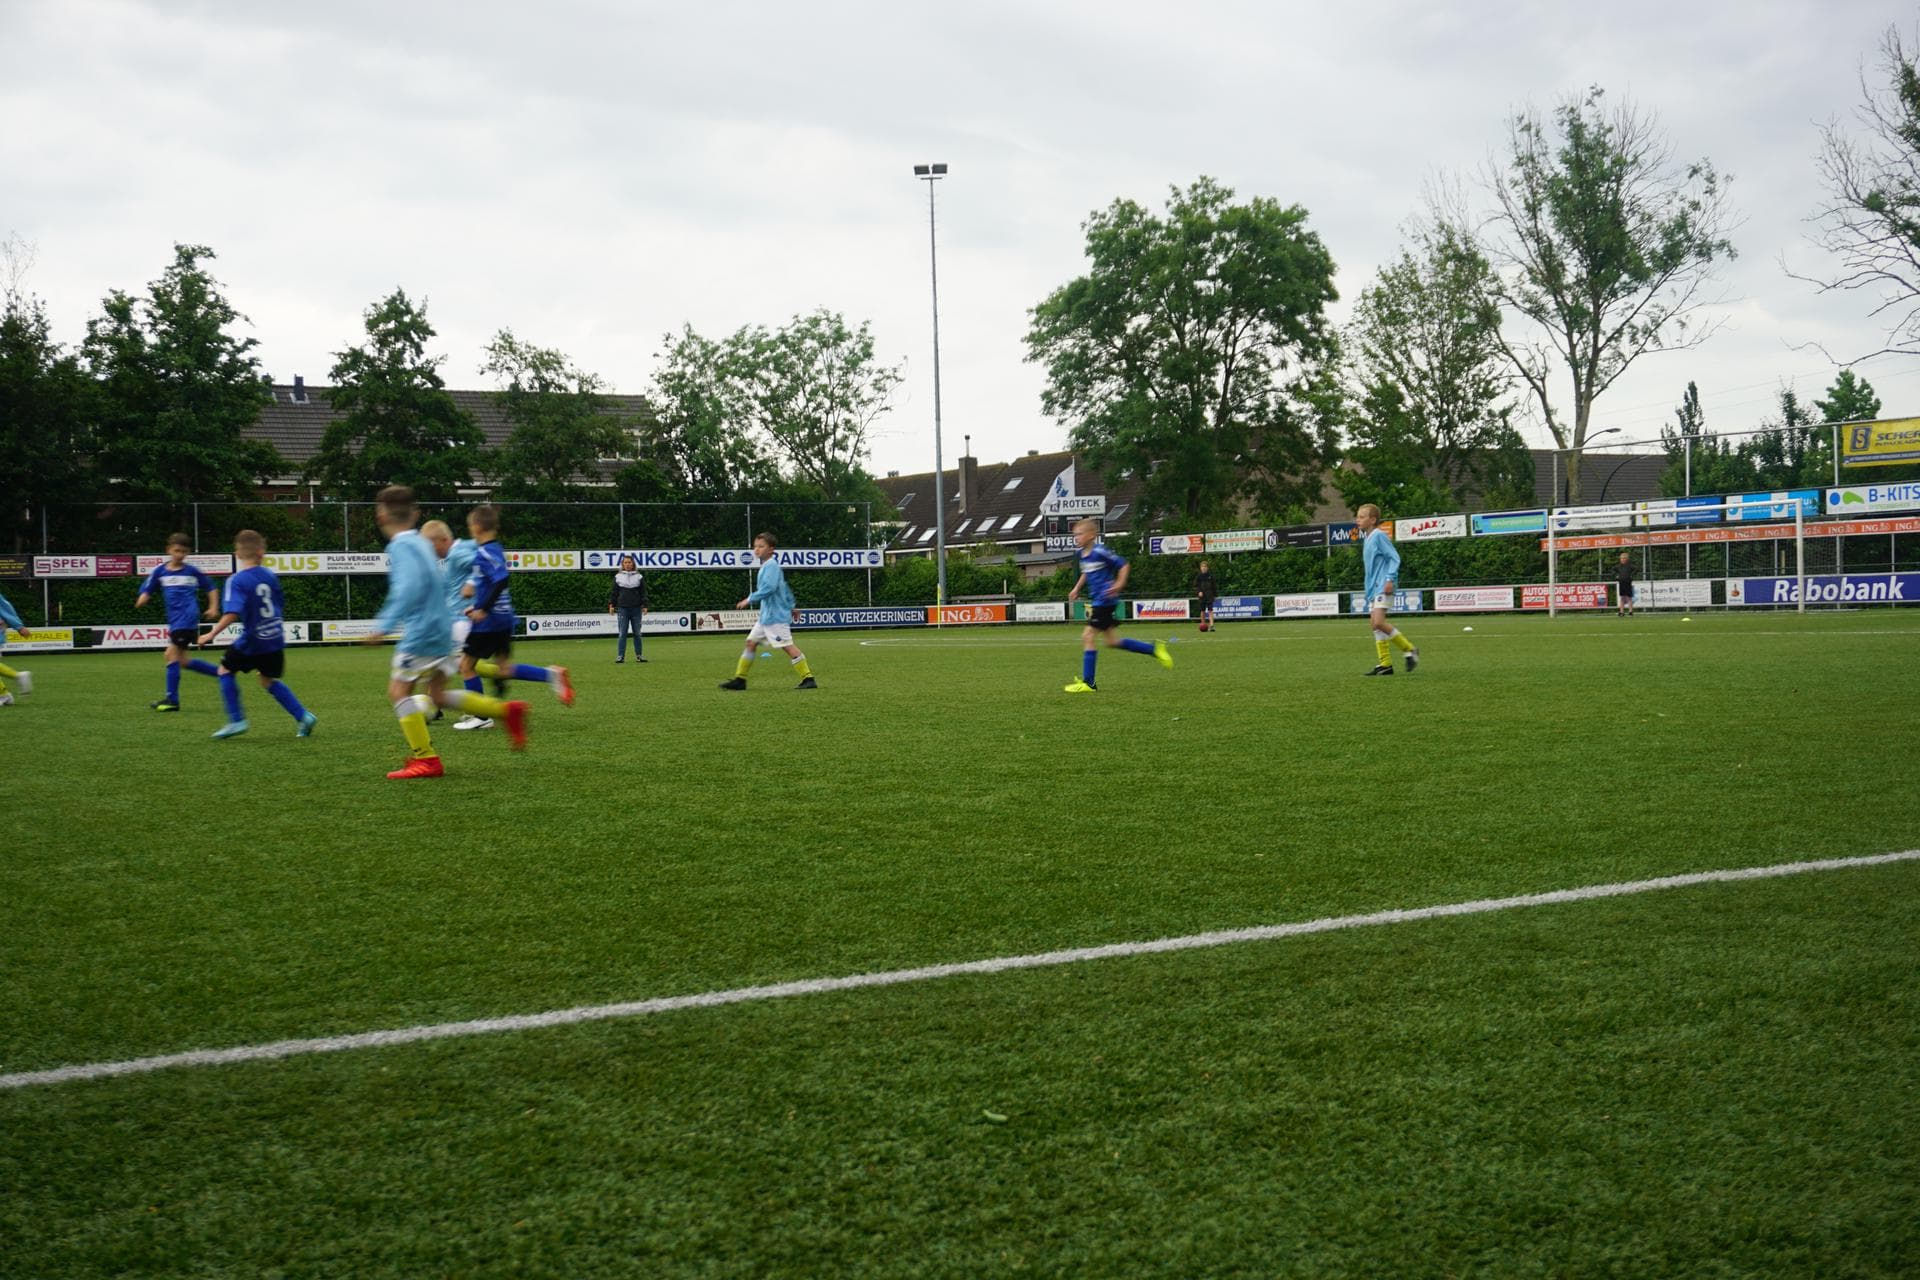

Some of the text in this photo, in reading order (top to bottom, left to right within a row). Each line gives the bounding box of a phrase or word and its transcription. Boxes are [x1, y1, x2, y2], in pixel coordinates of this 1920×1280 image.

[1062, 498, 1100, 508] ROTECK
[52, 558, 90, 568] SPEK
[262, 557, 320, 571] PLUS
[522, 554, 574, 567] PLUS
[605, 552, 735, 567] TANKOPSLAG
[760, 551, 864, 567] RANSPORT
[1773, 576, 1904, 602] Rabobank
[255, 583, 274, 618] 3
[809, 613, 836, 624] ROOK
[839, 610, 925, 624] VERZEKERINGEN
[941, 608, 971, 623] ING
[541, 617, 601, 632] de Onderlingen
[640, 618, 679, 630] nderlingen.nl
